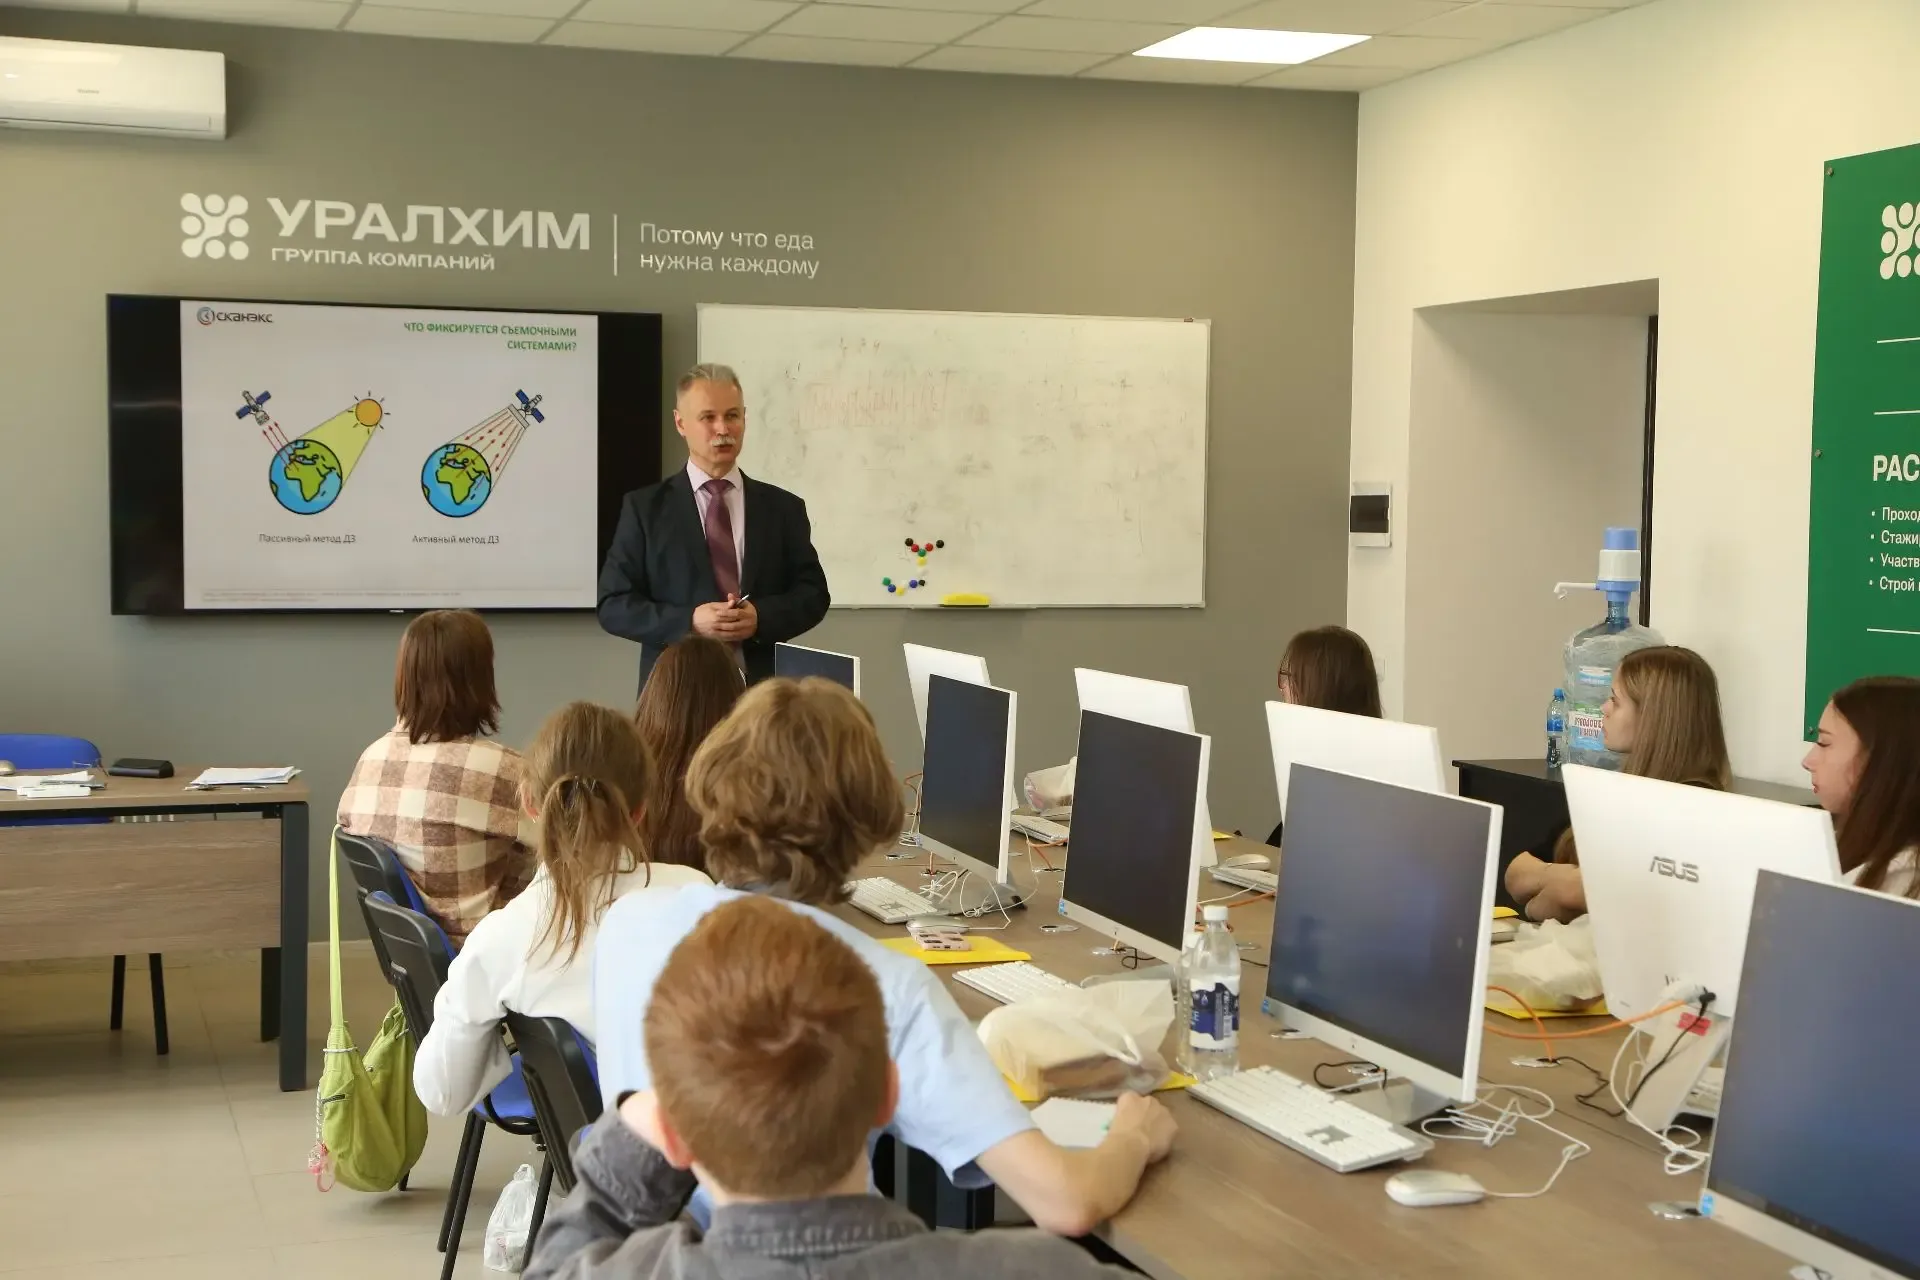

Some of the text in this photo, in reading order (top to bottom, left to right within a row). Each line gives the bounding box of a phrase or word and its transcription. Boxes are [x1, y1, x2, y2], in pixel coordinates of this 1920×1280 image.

[266, 197, 590, 250] УРАЛХИМ
[640, 222, 814, 252] Потому что еда
[271, 248, 495, 271] ГРУППА КОМПАНИЙ
[640, 253, 820, 279] нужна каждому
[404, 322, 577, 337] ЧТО ФИКСИРУЕТСЯ СЪЕМОЧНЫМИ
[507, 340, 577, 351] СИСТЕМАМИ?
[1873, 454, 1920, 482] РАС
[258, 533, 311, 543] Пассивный
[312, 535, 341, 544] метод
[412, 534, 456, 544] Активный
[458, 536, 486, 545] метод
[1881, 529, 1920, 547] Стажи
[1879, 576, 1915, 594] Строй
[1650, 856, 1700, 882] ASUS
